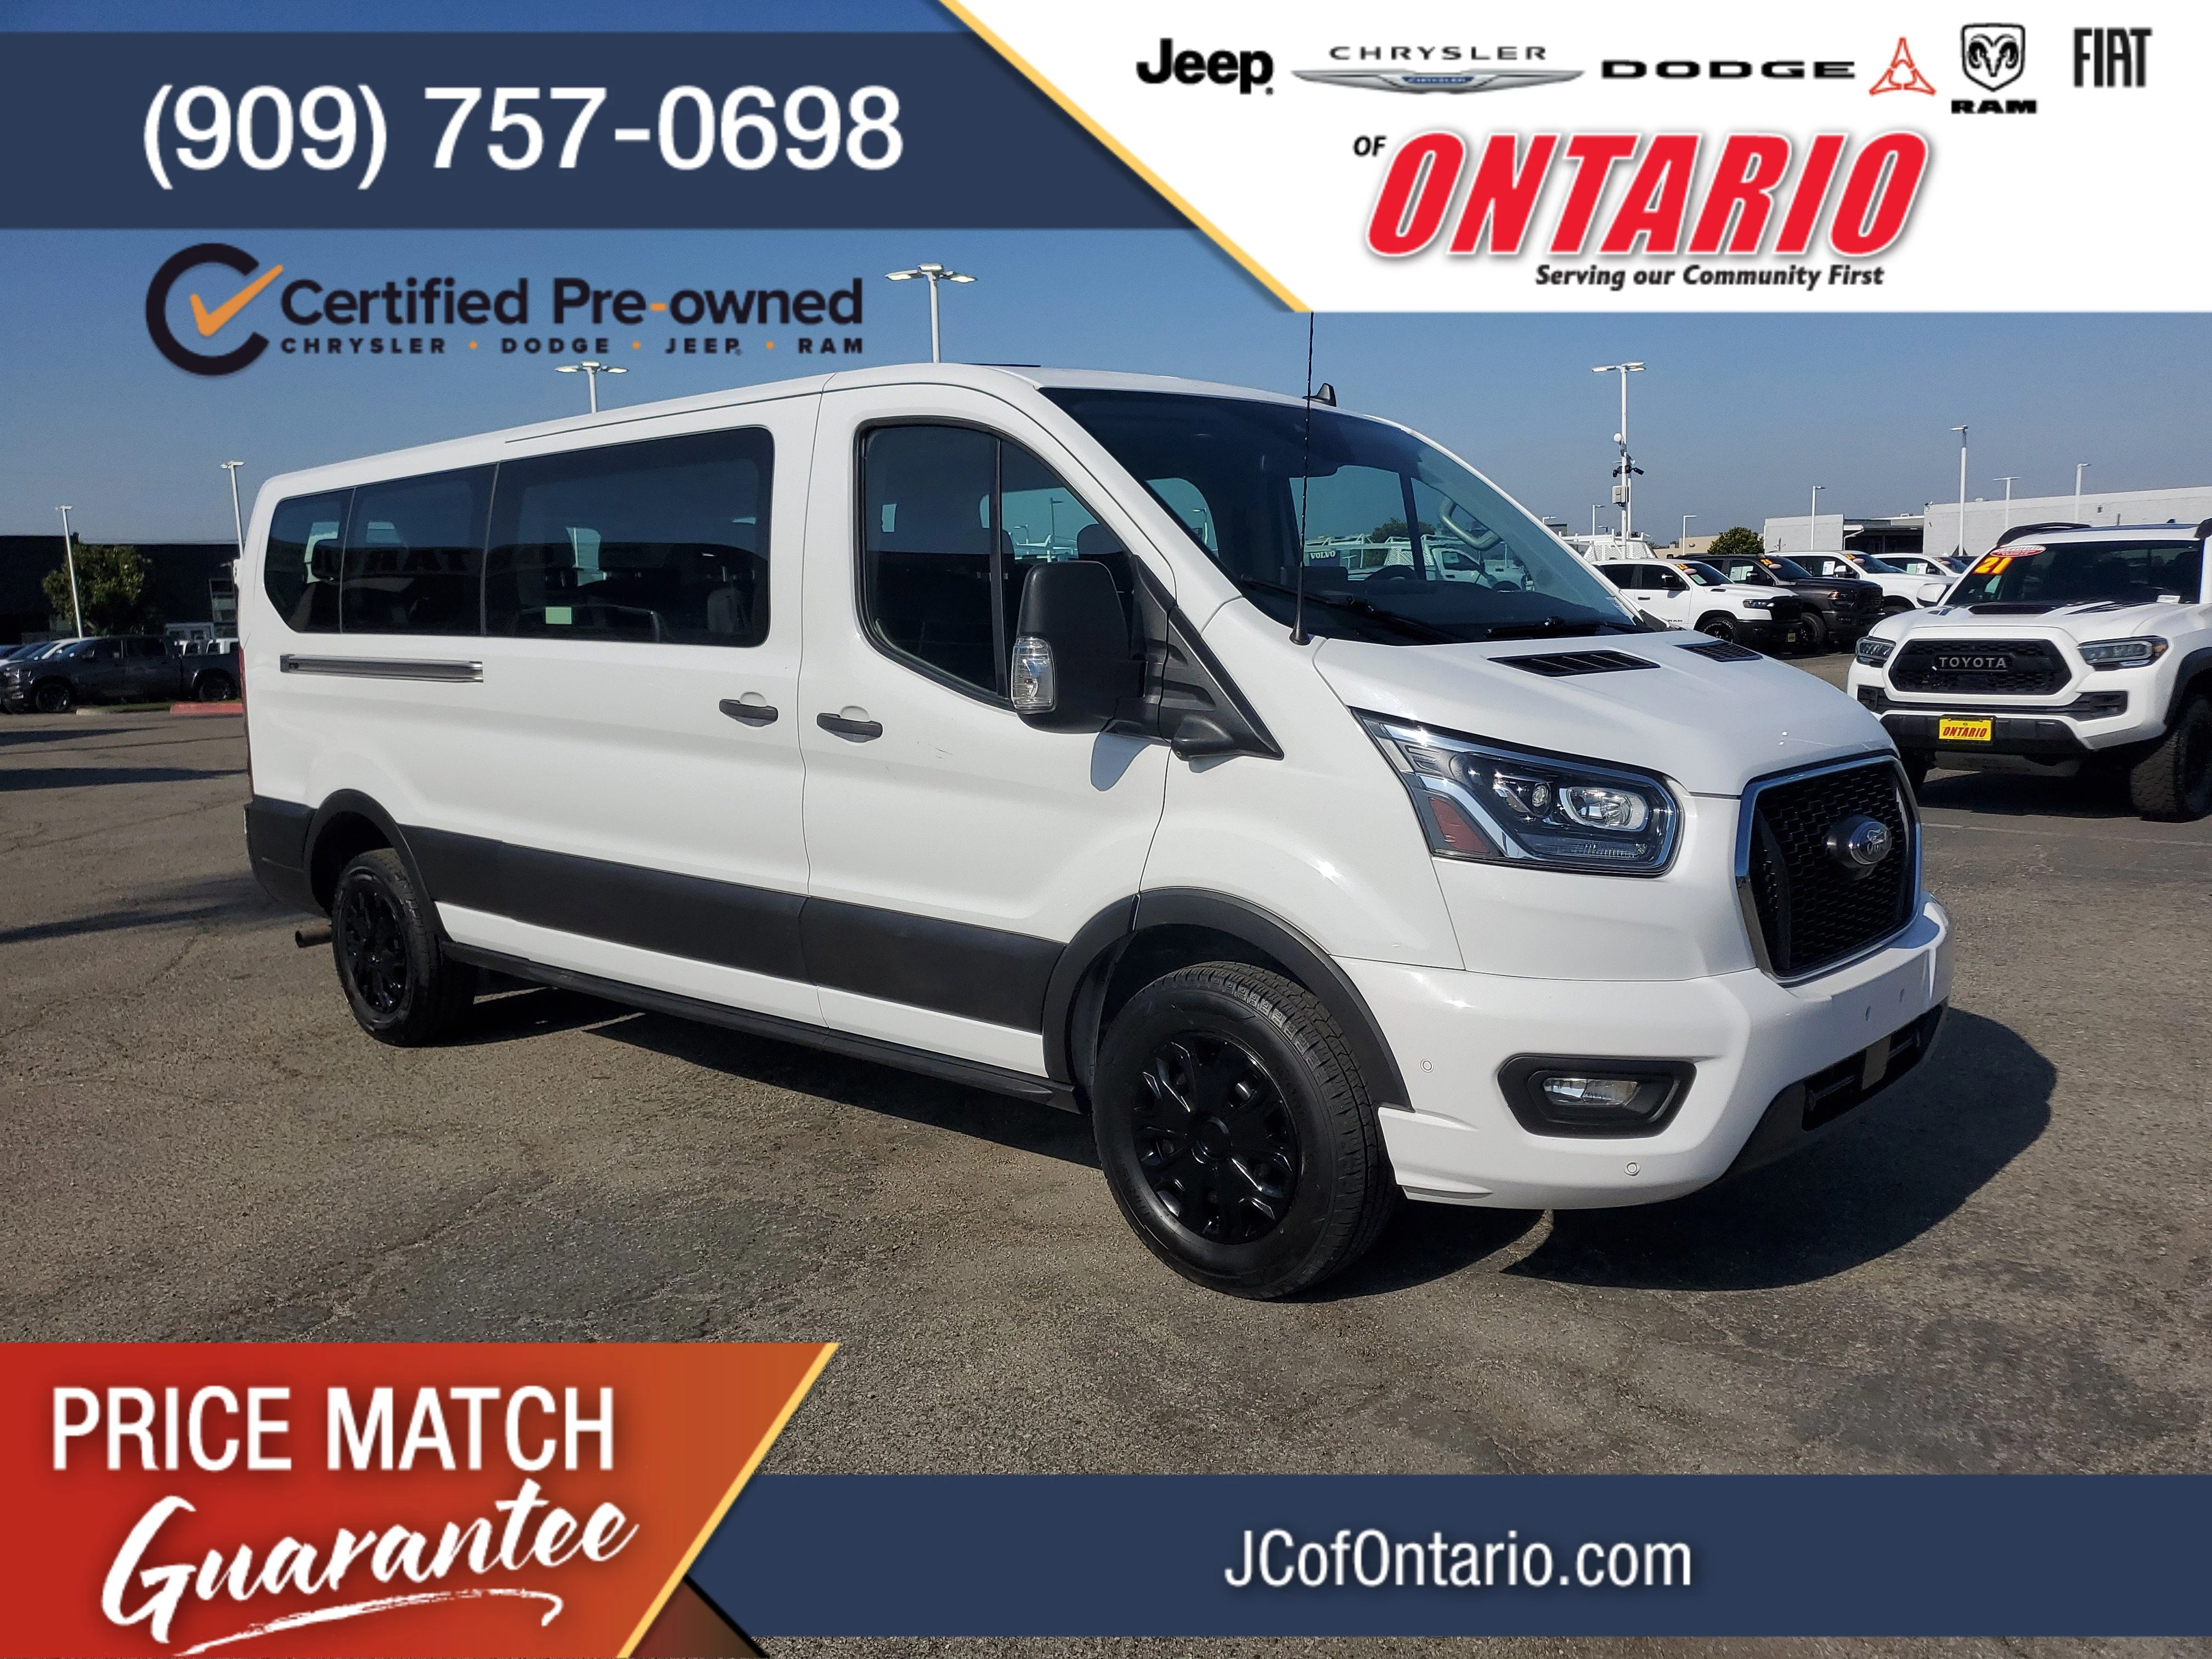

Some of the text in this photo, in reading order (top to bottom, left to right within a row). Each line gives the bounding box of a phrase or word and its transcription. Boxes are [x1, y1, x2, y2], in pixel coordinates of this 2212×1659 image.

[1310, 550, 1336, 559] VOLVO
[1973, 556, 2014, 574] 21
[1938, 657, 2007, 668] TOYOTA
[1943, 726, 1988, 737] ONTARIO
